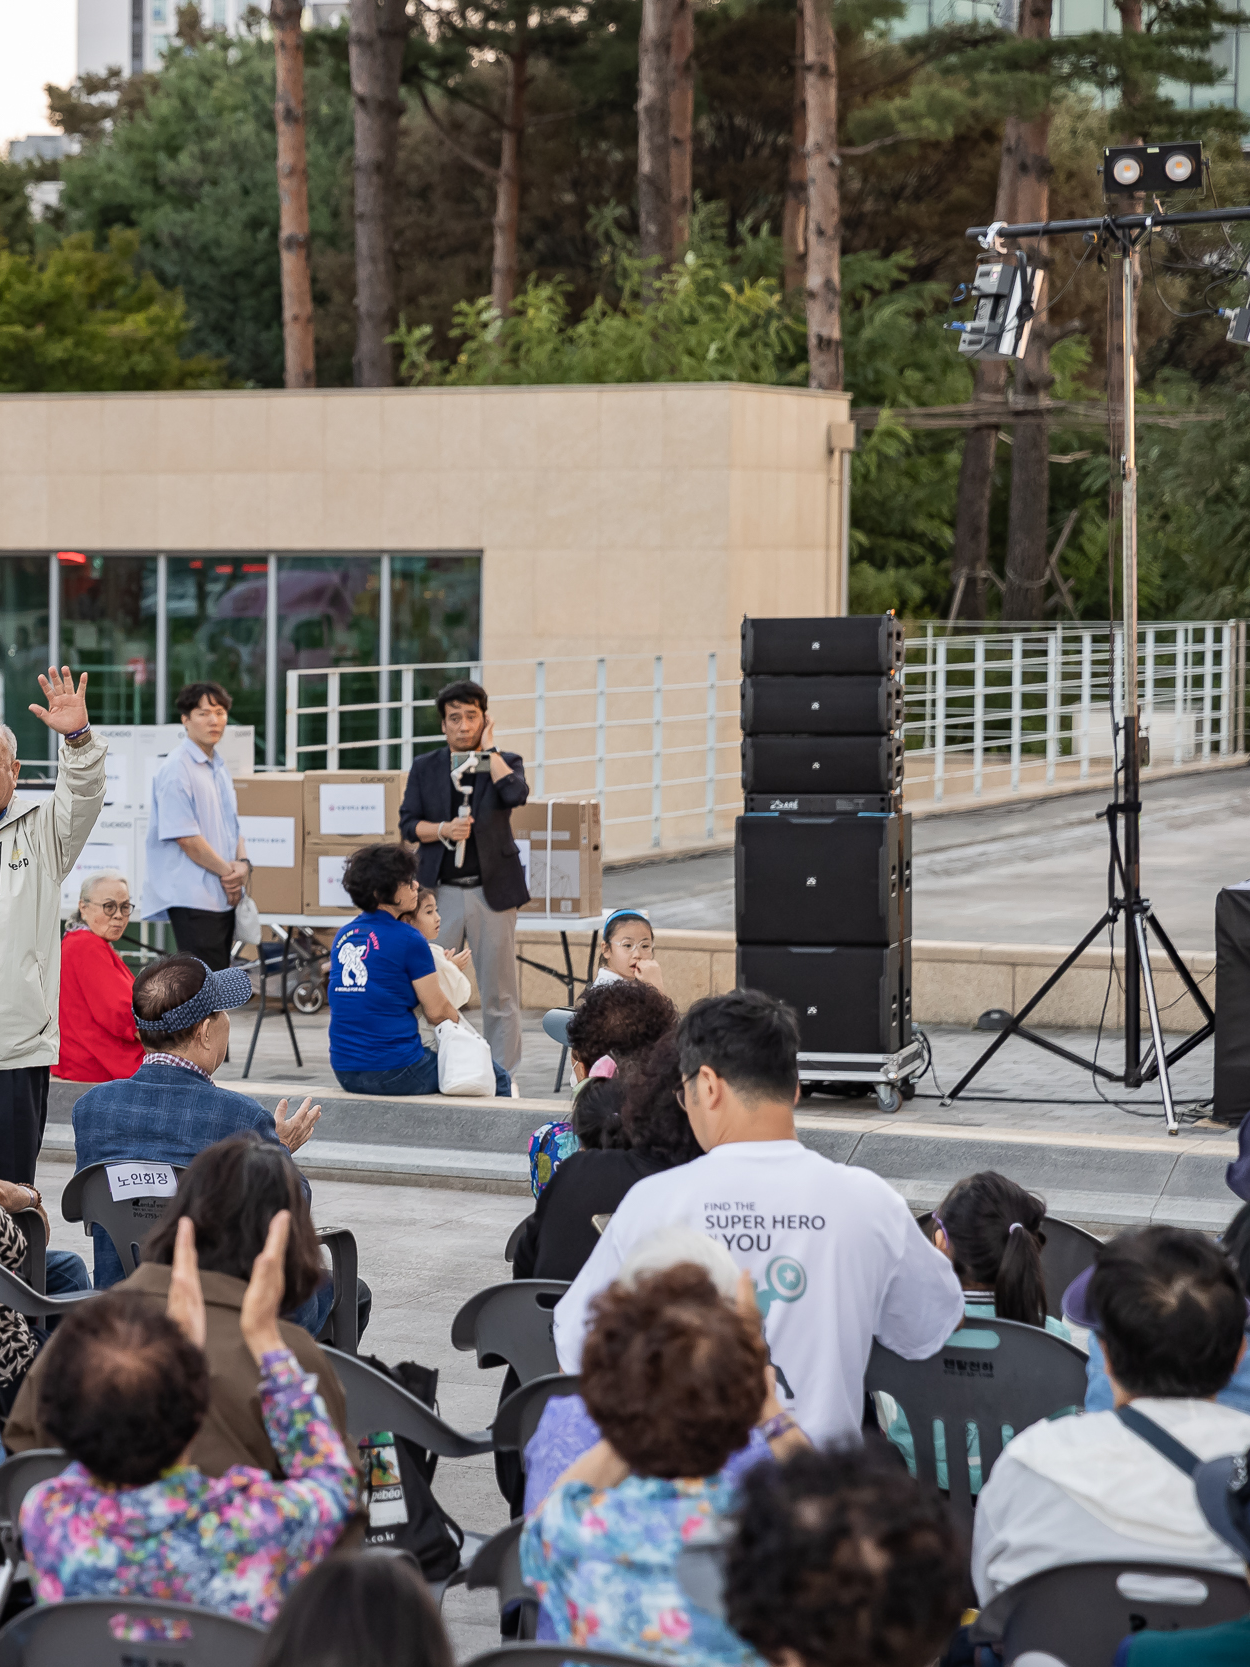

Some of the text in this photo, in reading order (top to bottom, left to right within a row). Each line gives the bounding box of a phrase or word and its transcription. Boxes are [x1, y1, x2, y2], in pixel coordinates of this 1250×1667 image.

[117, 1172, 168, 1188] 노인회장
[704, 1201, 756, 1212] FIND THE
[705, 1214, 826, 1231] SUPER HERO
[722, 1233, 771, 1252] YOU
